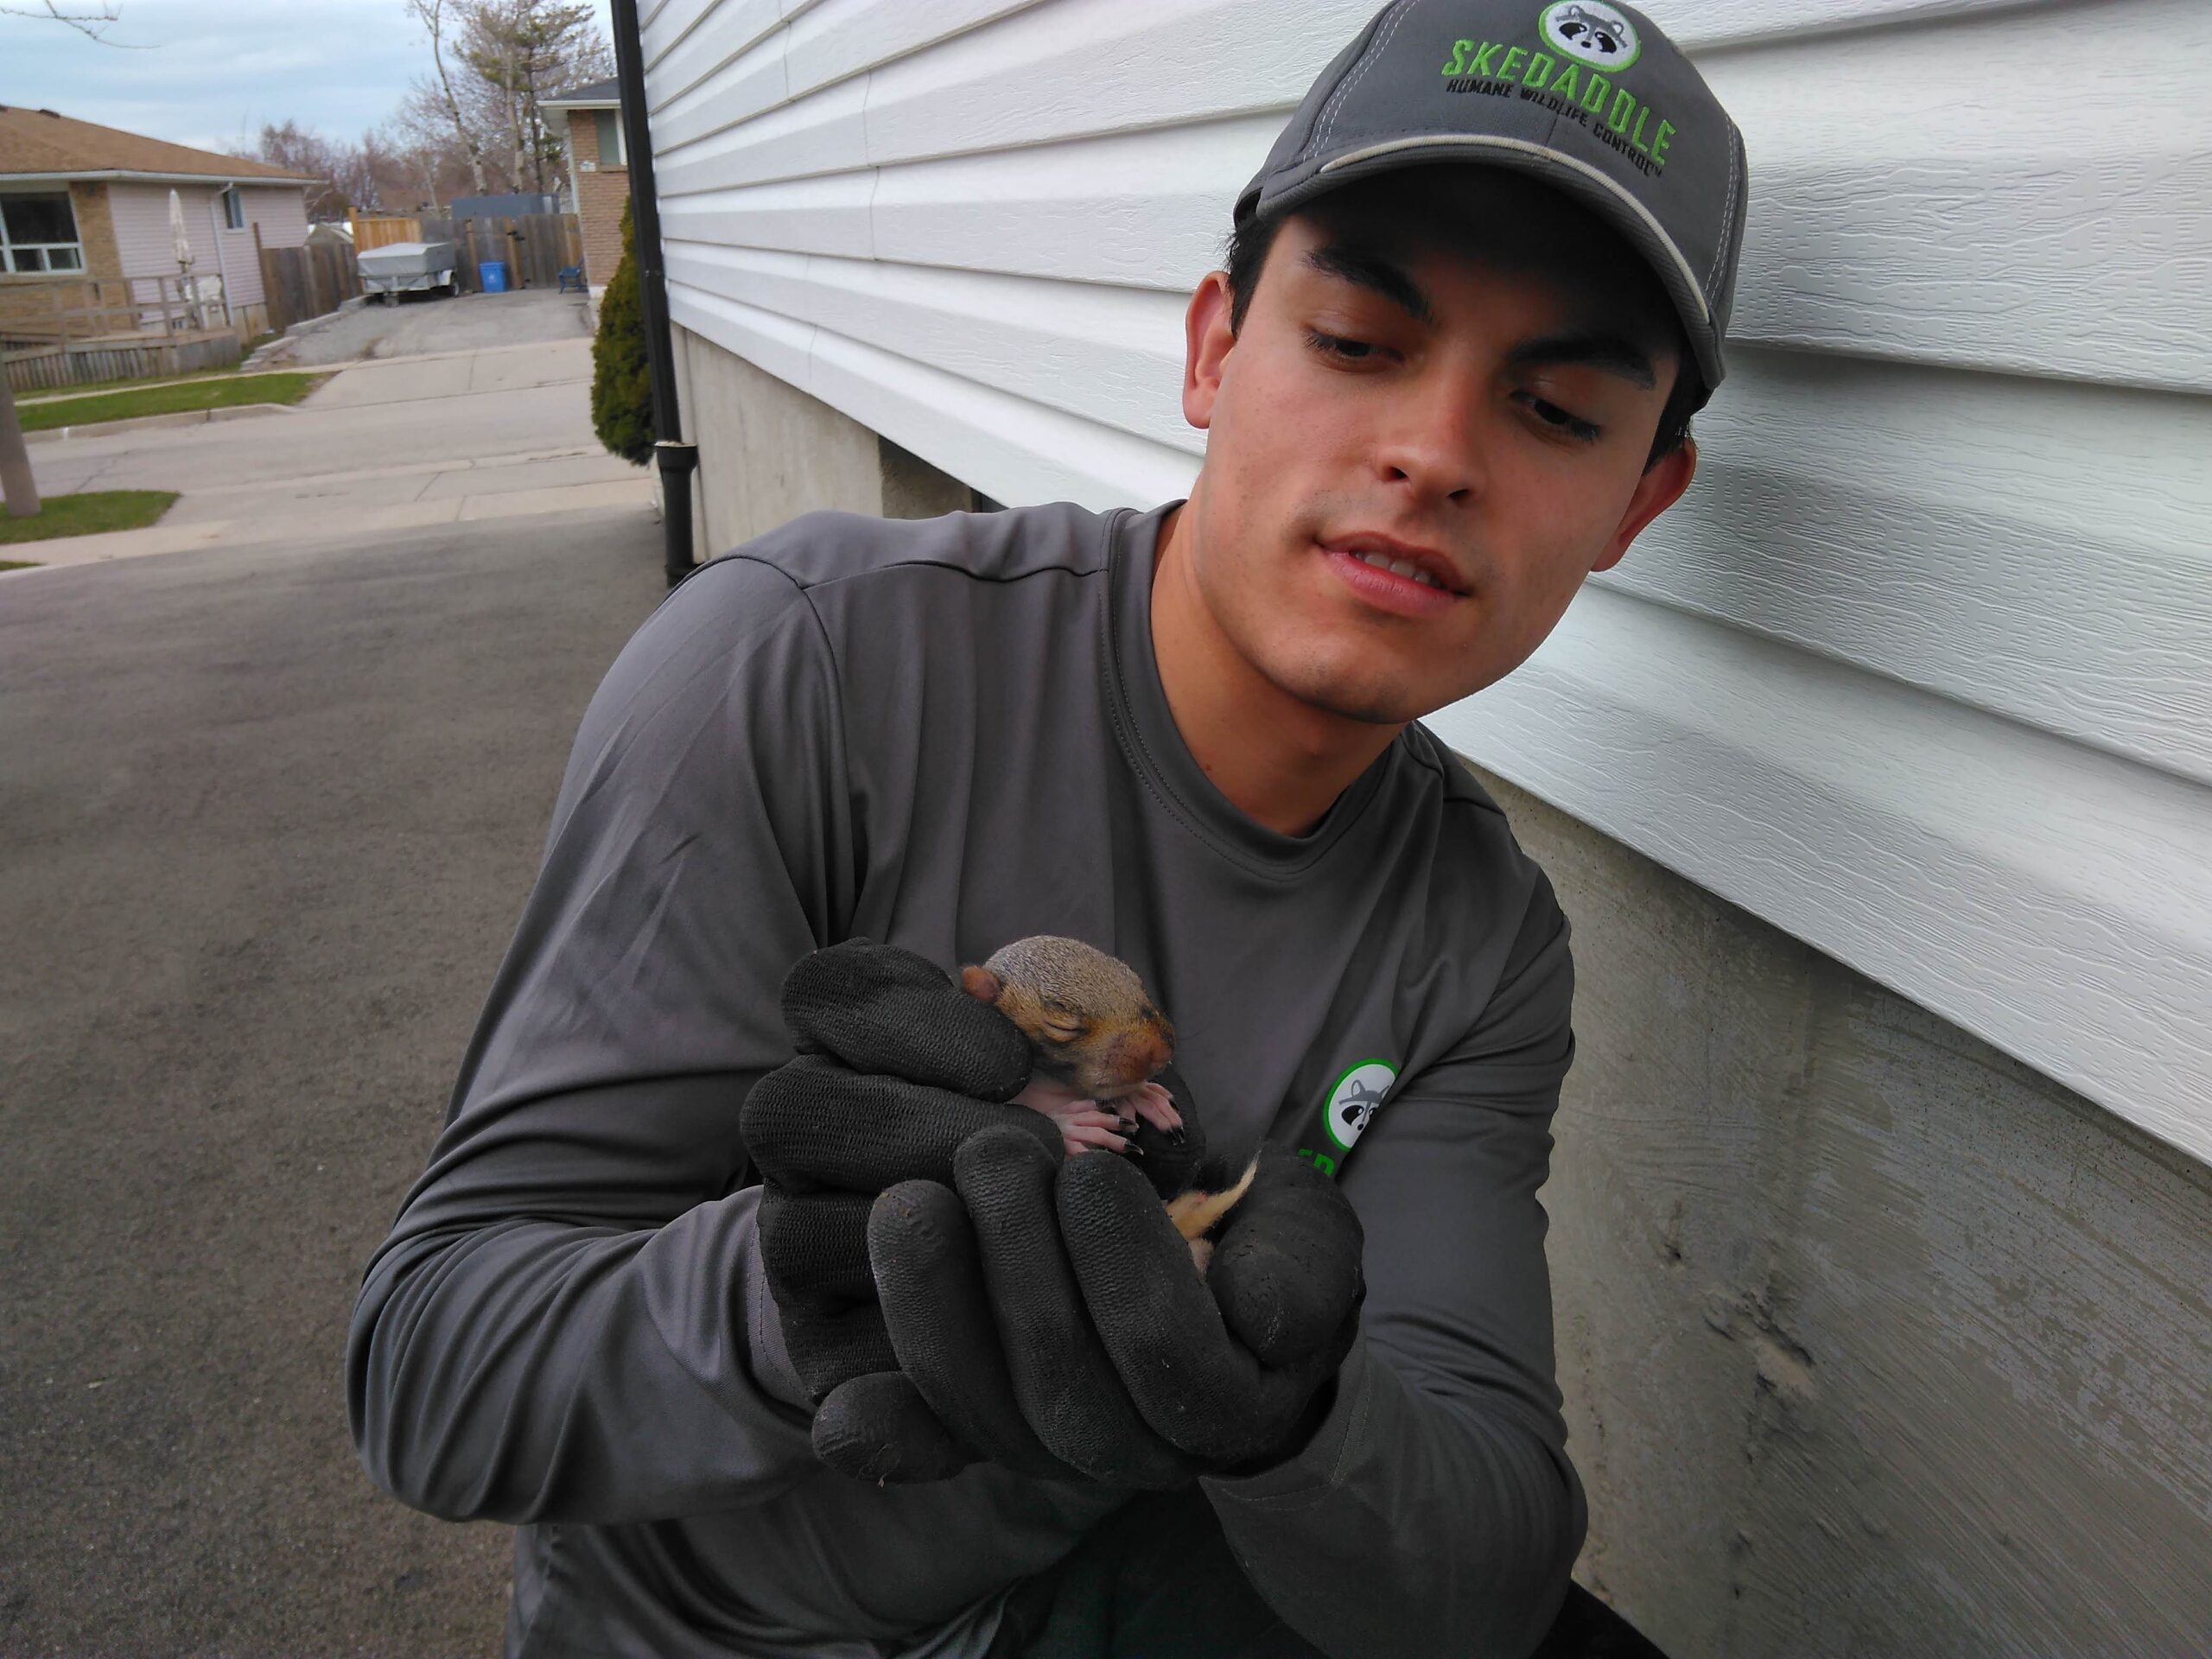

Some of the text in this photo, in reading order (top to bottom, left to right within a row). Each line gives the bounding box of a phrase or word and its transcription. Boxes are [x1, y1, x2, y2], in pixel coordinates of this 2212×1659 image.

[1441, 39, 1676, 165] SKEDADDLE
[1446, 79, 1514, 98] HUMANE
[1520, 88, 1588, 128] WILDLIFE
